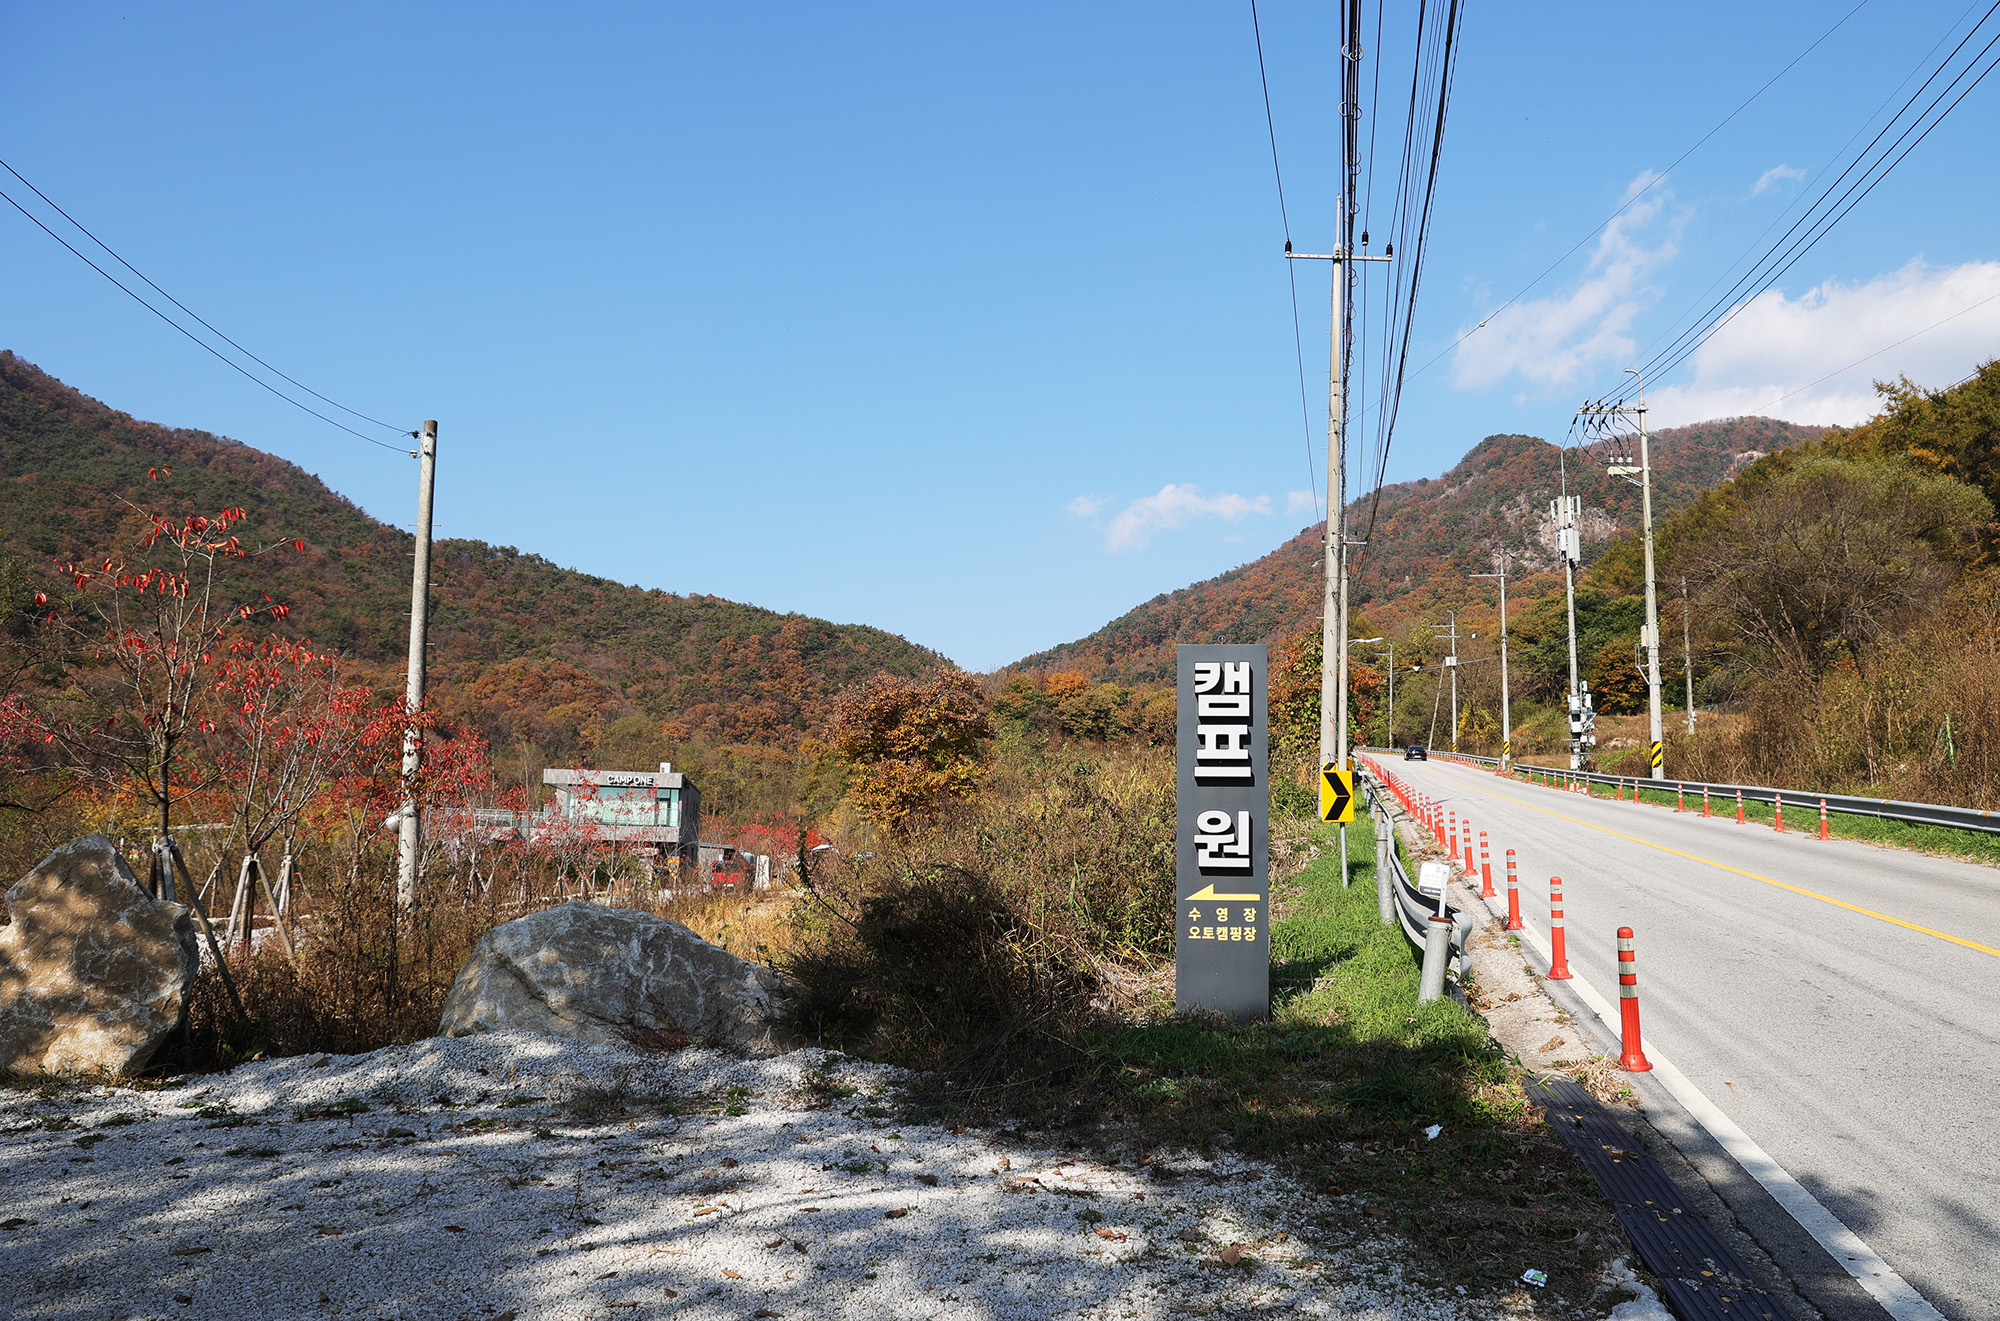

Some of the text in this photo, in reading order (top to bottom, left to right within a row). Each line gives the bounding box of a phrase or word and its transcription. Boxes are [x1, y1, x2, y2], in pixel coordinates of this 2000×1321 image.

[607, 775, 653, 785] CAMP ONE
[1188, 926, 1257, 941] 오토캠핑장
